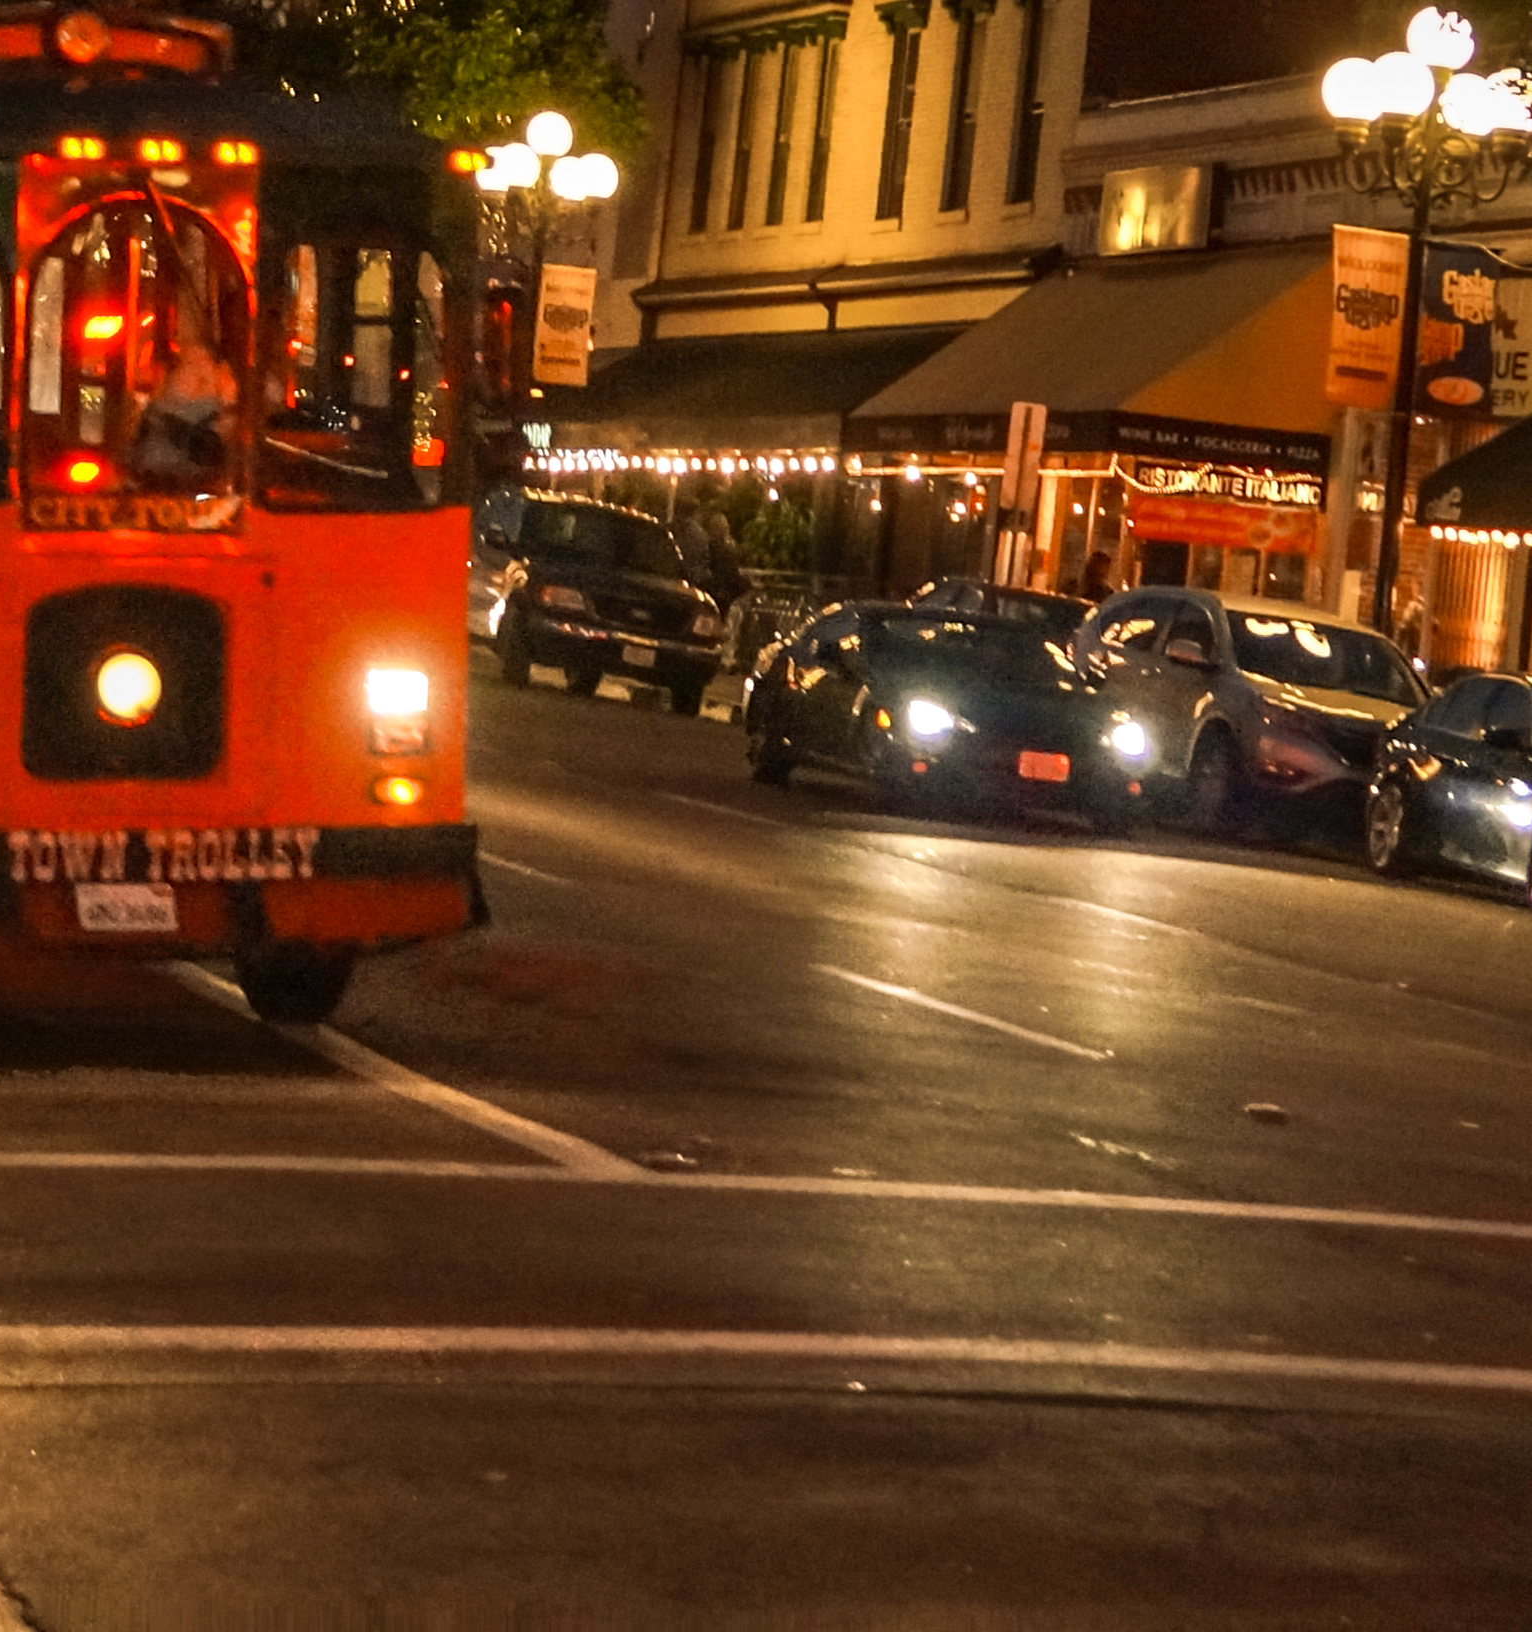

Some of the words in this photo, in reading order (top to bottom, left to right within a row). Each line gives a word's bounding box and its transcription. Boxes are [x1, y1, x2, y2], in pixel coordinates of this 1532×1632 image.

[1137, 466, 1245, 499] RISTORANTE
[1245, 478, 1322, 505] ITALIANO
[7, 829, 128, 883] TOWN
[145, 827, 320, 883] TROLLEY
